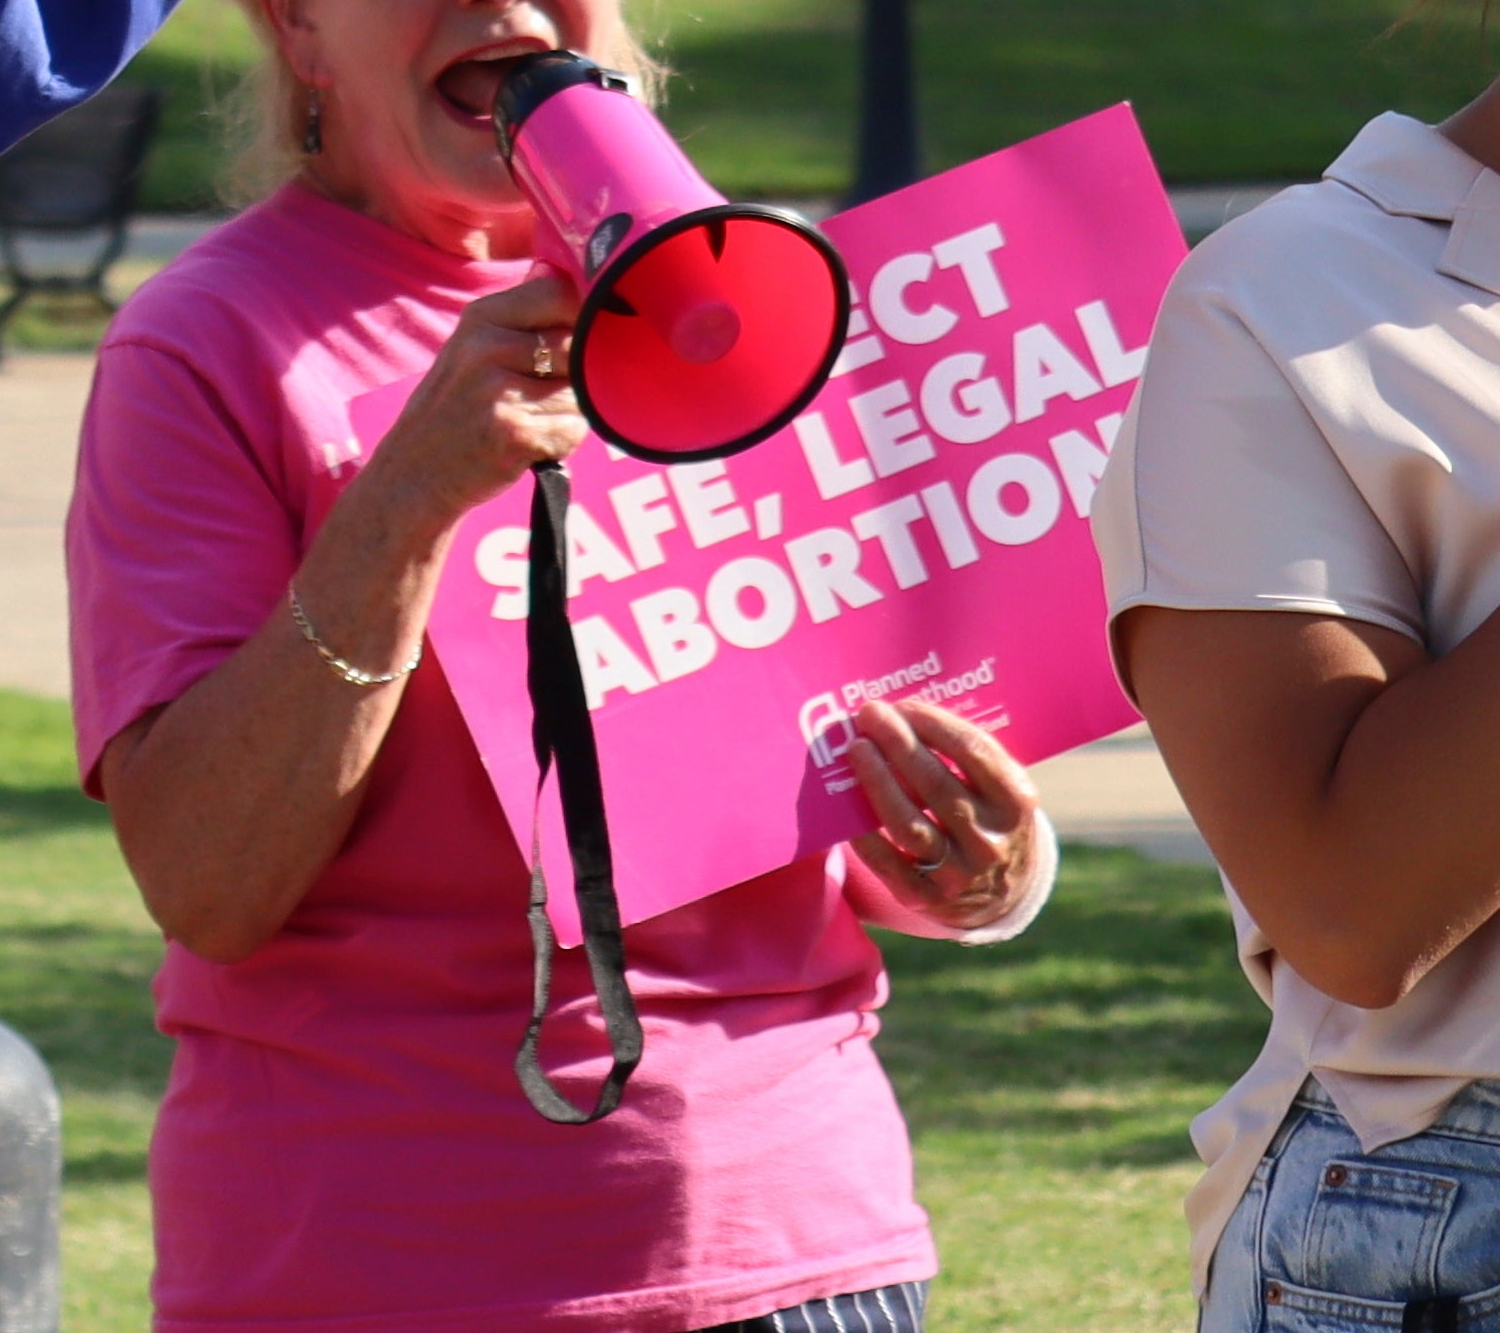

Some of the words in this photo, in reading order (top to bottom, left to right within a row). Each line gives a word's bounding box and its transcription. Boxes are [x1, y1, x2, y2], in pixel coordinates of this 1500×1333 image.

[473, 458, 782, 621] SAFE,
[793, 298, 1151, 502] LEGAL
[840, 650, 943, 708] Planned
